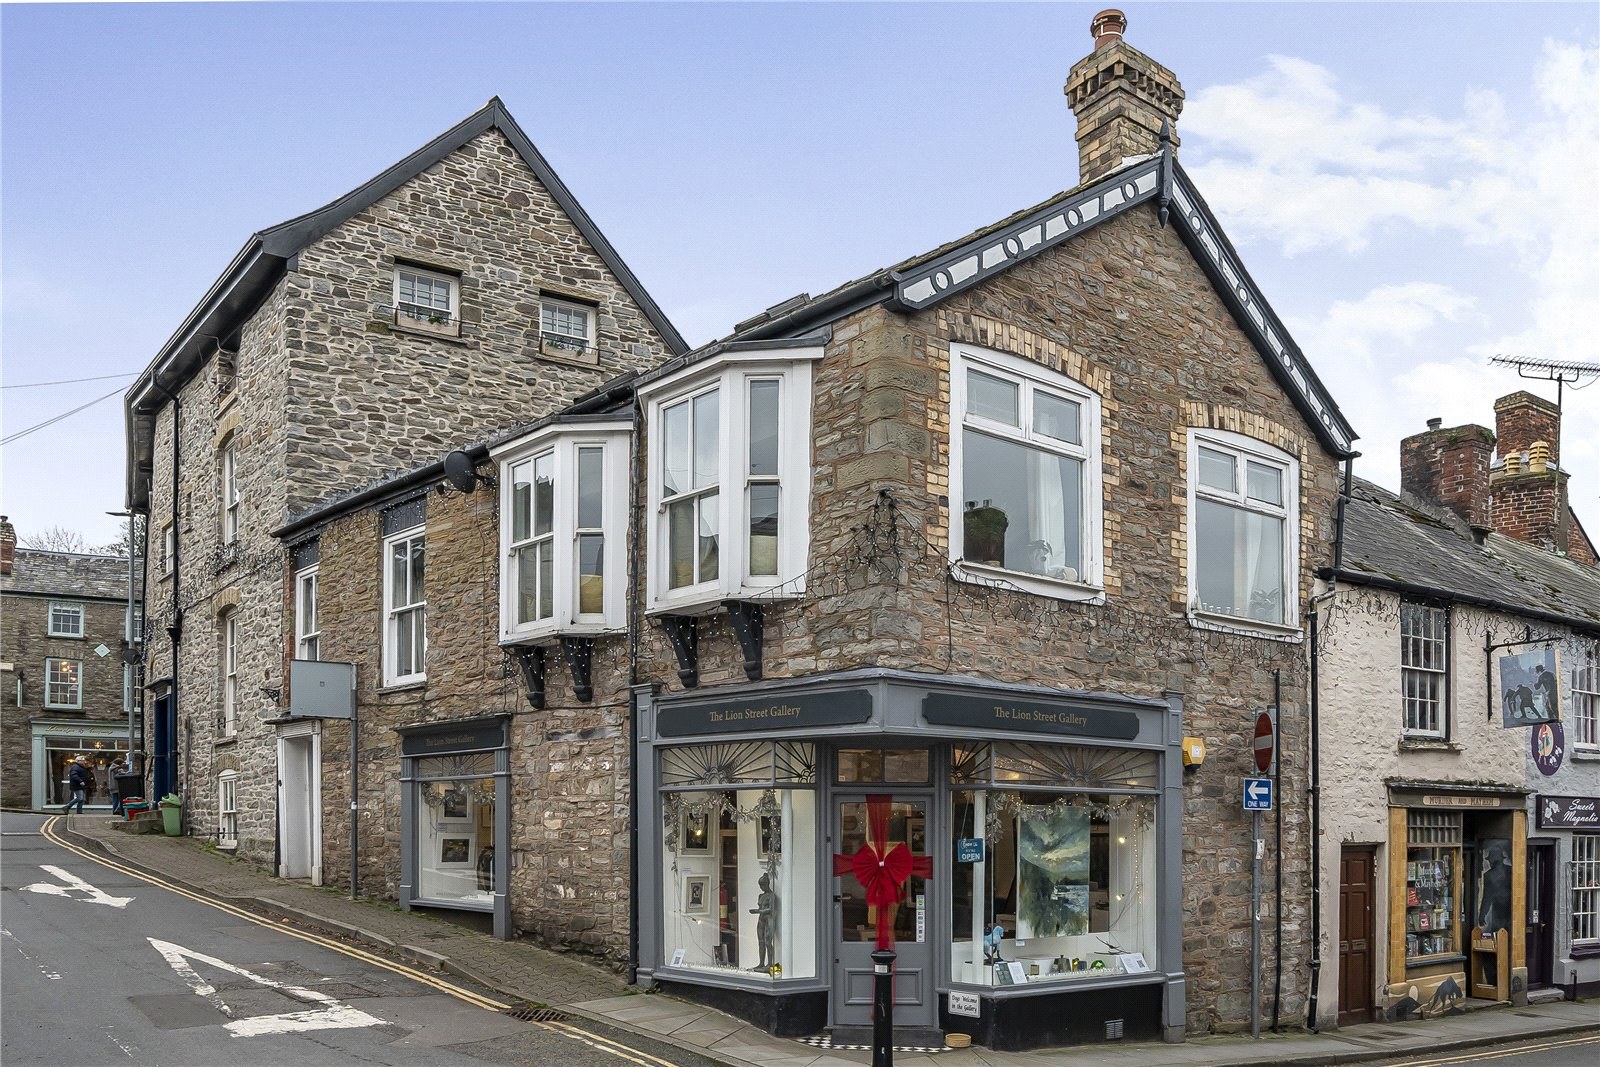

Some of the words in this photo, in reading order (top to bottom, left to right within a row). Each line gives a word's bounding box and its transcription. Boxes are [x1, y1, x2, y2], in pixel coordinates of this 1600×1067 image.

[709, 711, 723, 721] The
[725, 710, 743, 720] Lion
[745, 708, 768, 719] Street
[770, 705, 800, 718] Gallery
[993, 706, 1010, 718] The
[1012, 708, 1031, 720] Lion
[1033, 710, 1057, 722] Street
[1059, 712, 1088, 727] Gallery
[1569, 799, 1595, 811] Sweets
[1563, 810, 1599, 826] Magnolia
